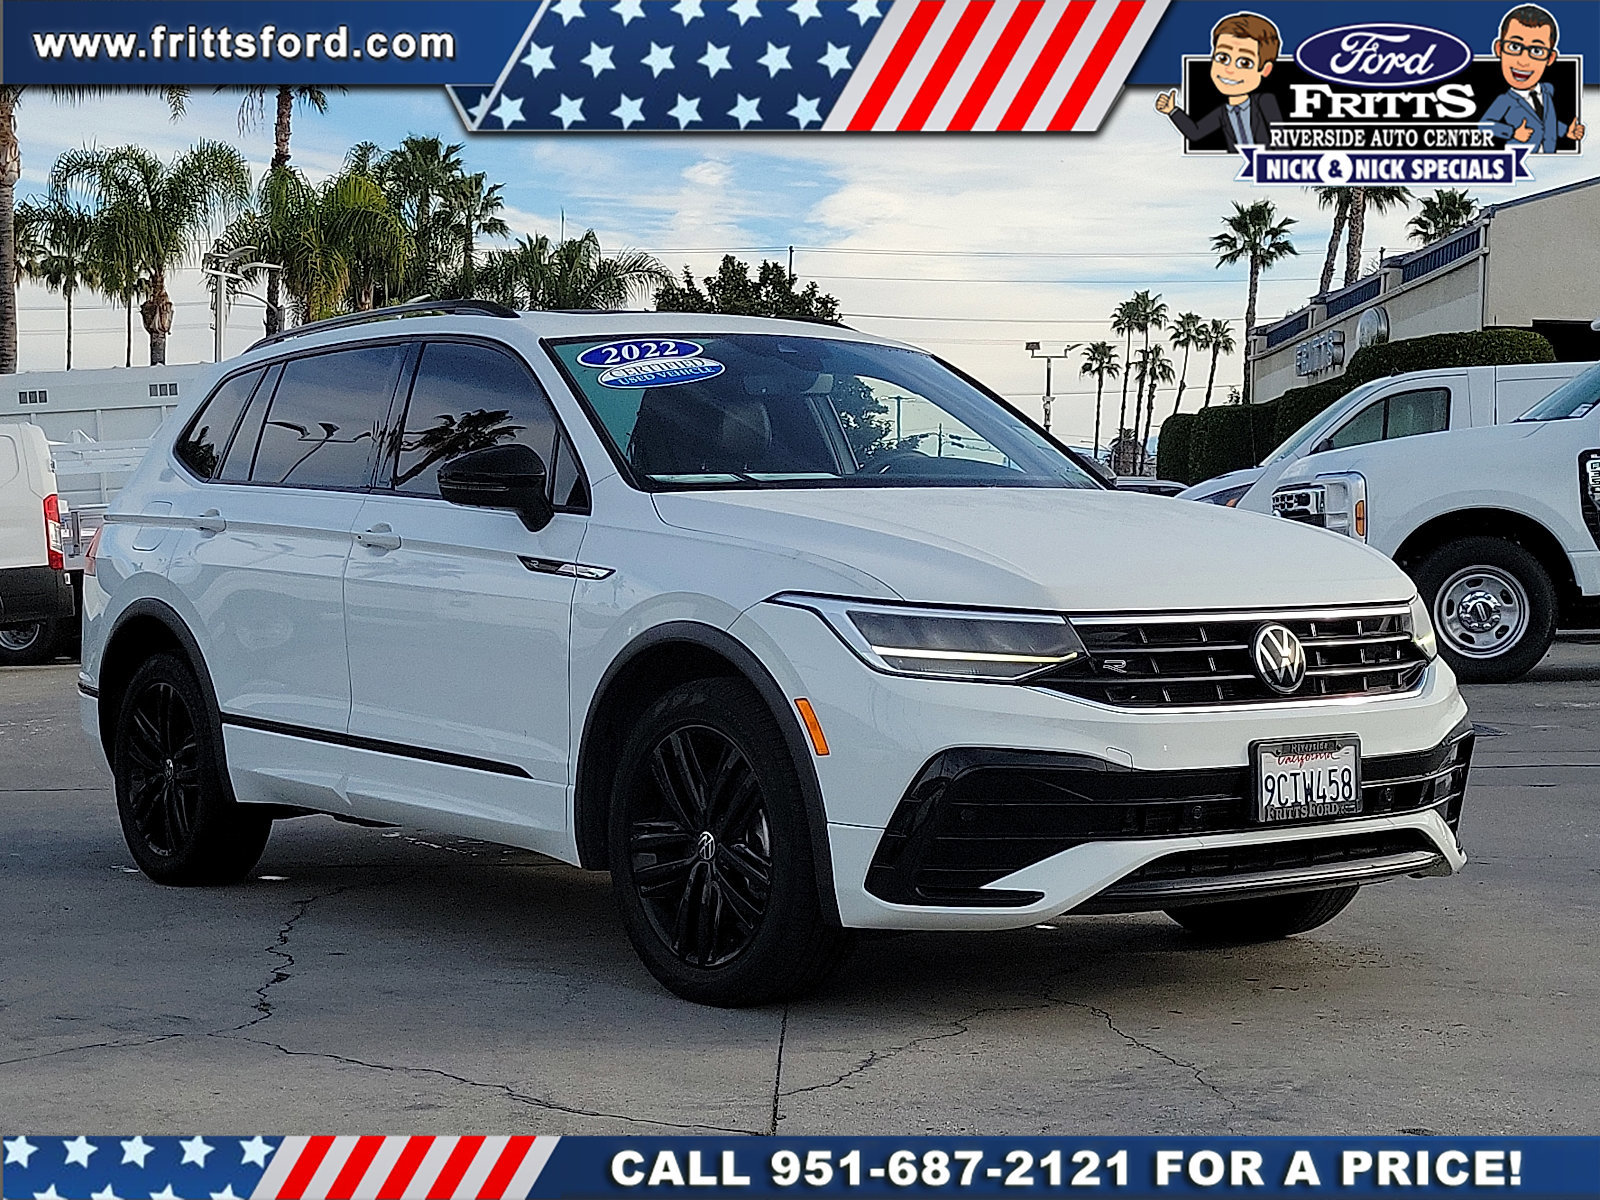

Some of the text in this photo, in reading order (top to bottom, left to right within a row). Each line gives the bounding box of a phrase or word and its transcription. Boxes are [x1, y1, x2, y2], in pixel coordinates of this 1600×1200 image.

[601, 341, 679, 364] 2022
[609, 358, 706, 378] CERTIFIED
[617, 366, 716, 386] USED VEHICLE
[1264, 768, 1353, 806] 9CIW458
